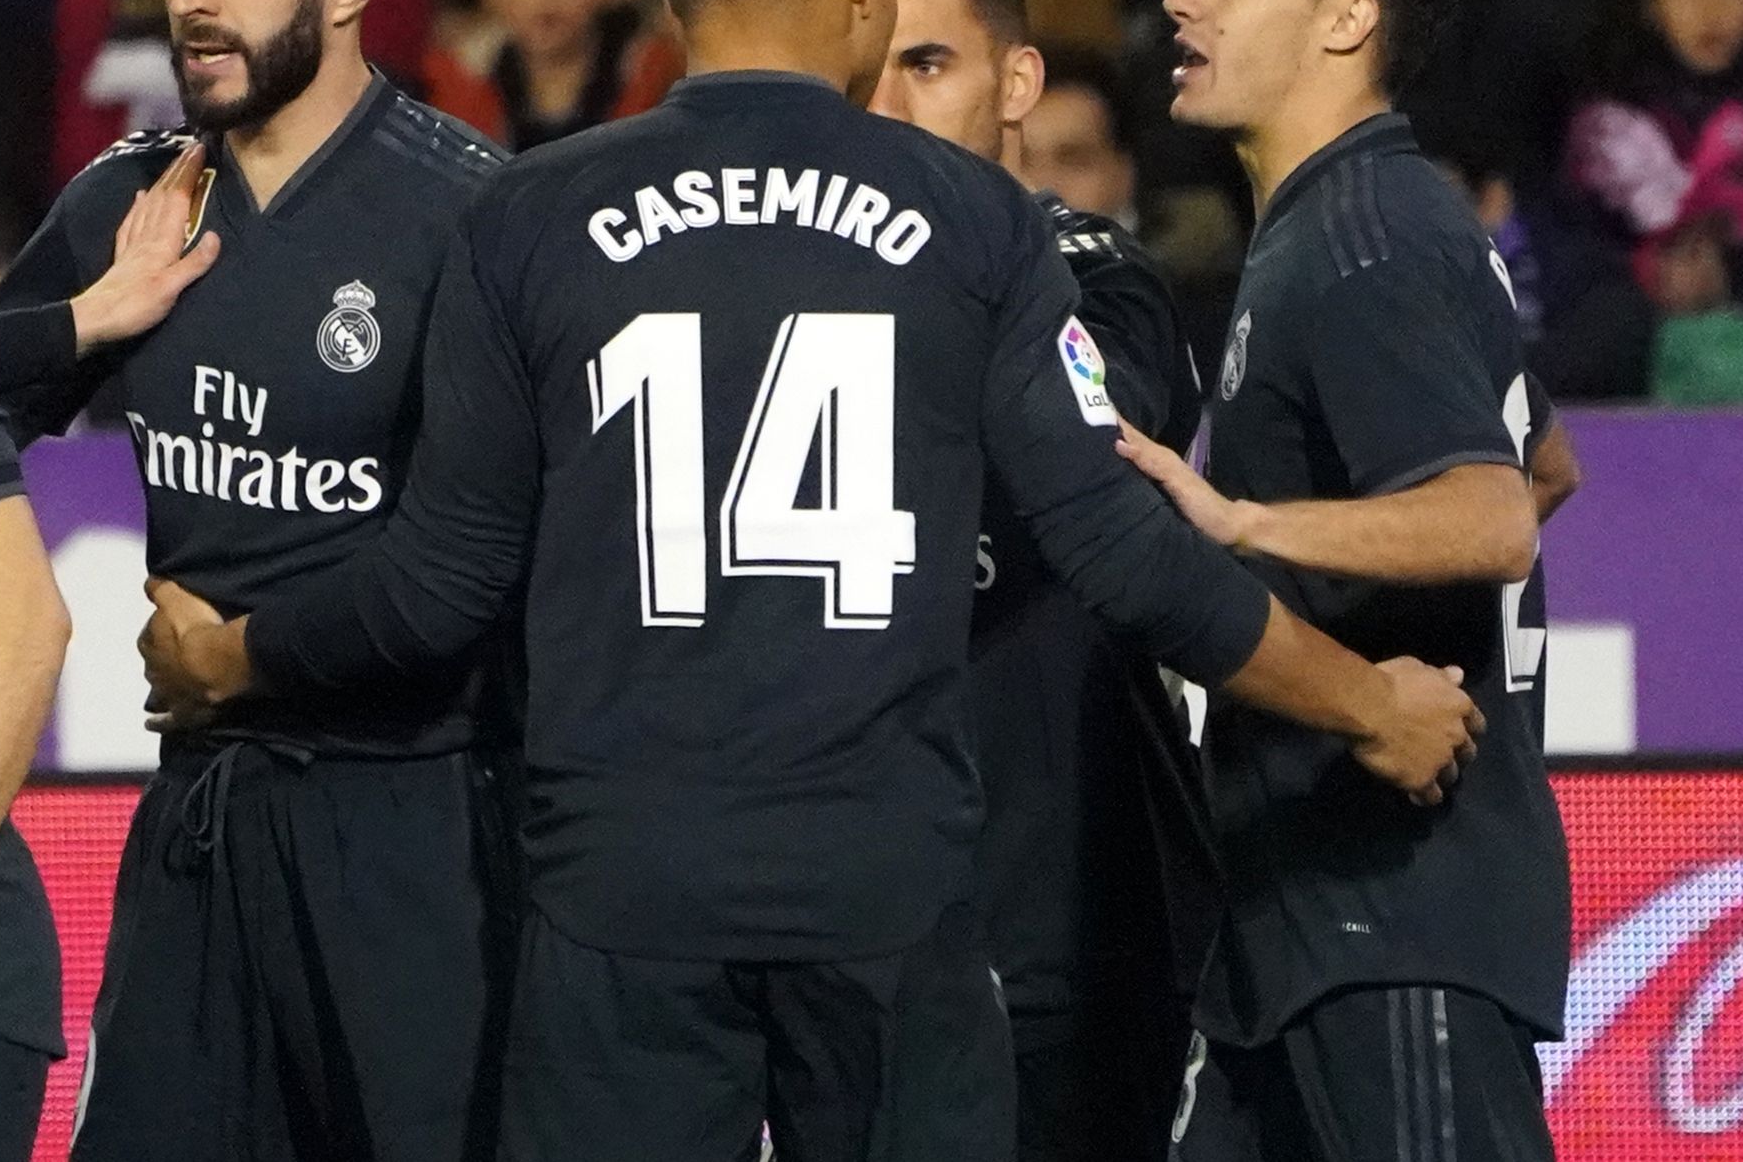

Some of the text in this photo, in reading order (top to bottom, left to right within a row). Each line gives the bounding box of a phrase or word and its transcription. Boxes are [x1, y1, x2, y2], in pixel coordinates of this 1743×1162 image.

[588, 167, 932, 266] CASEMIRO
[193, 364, 268, 437] Fly
[1083, 392, 1111, 408] LaL
[586, 312, 917, 630] 14
